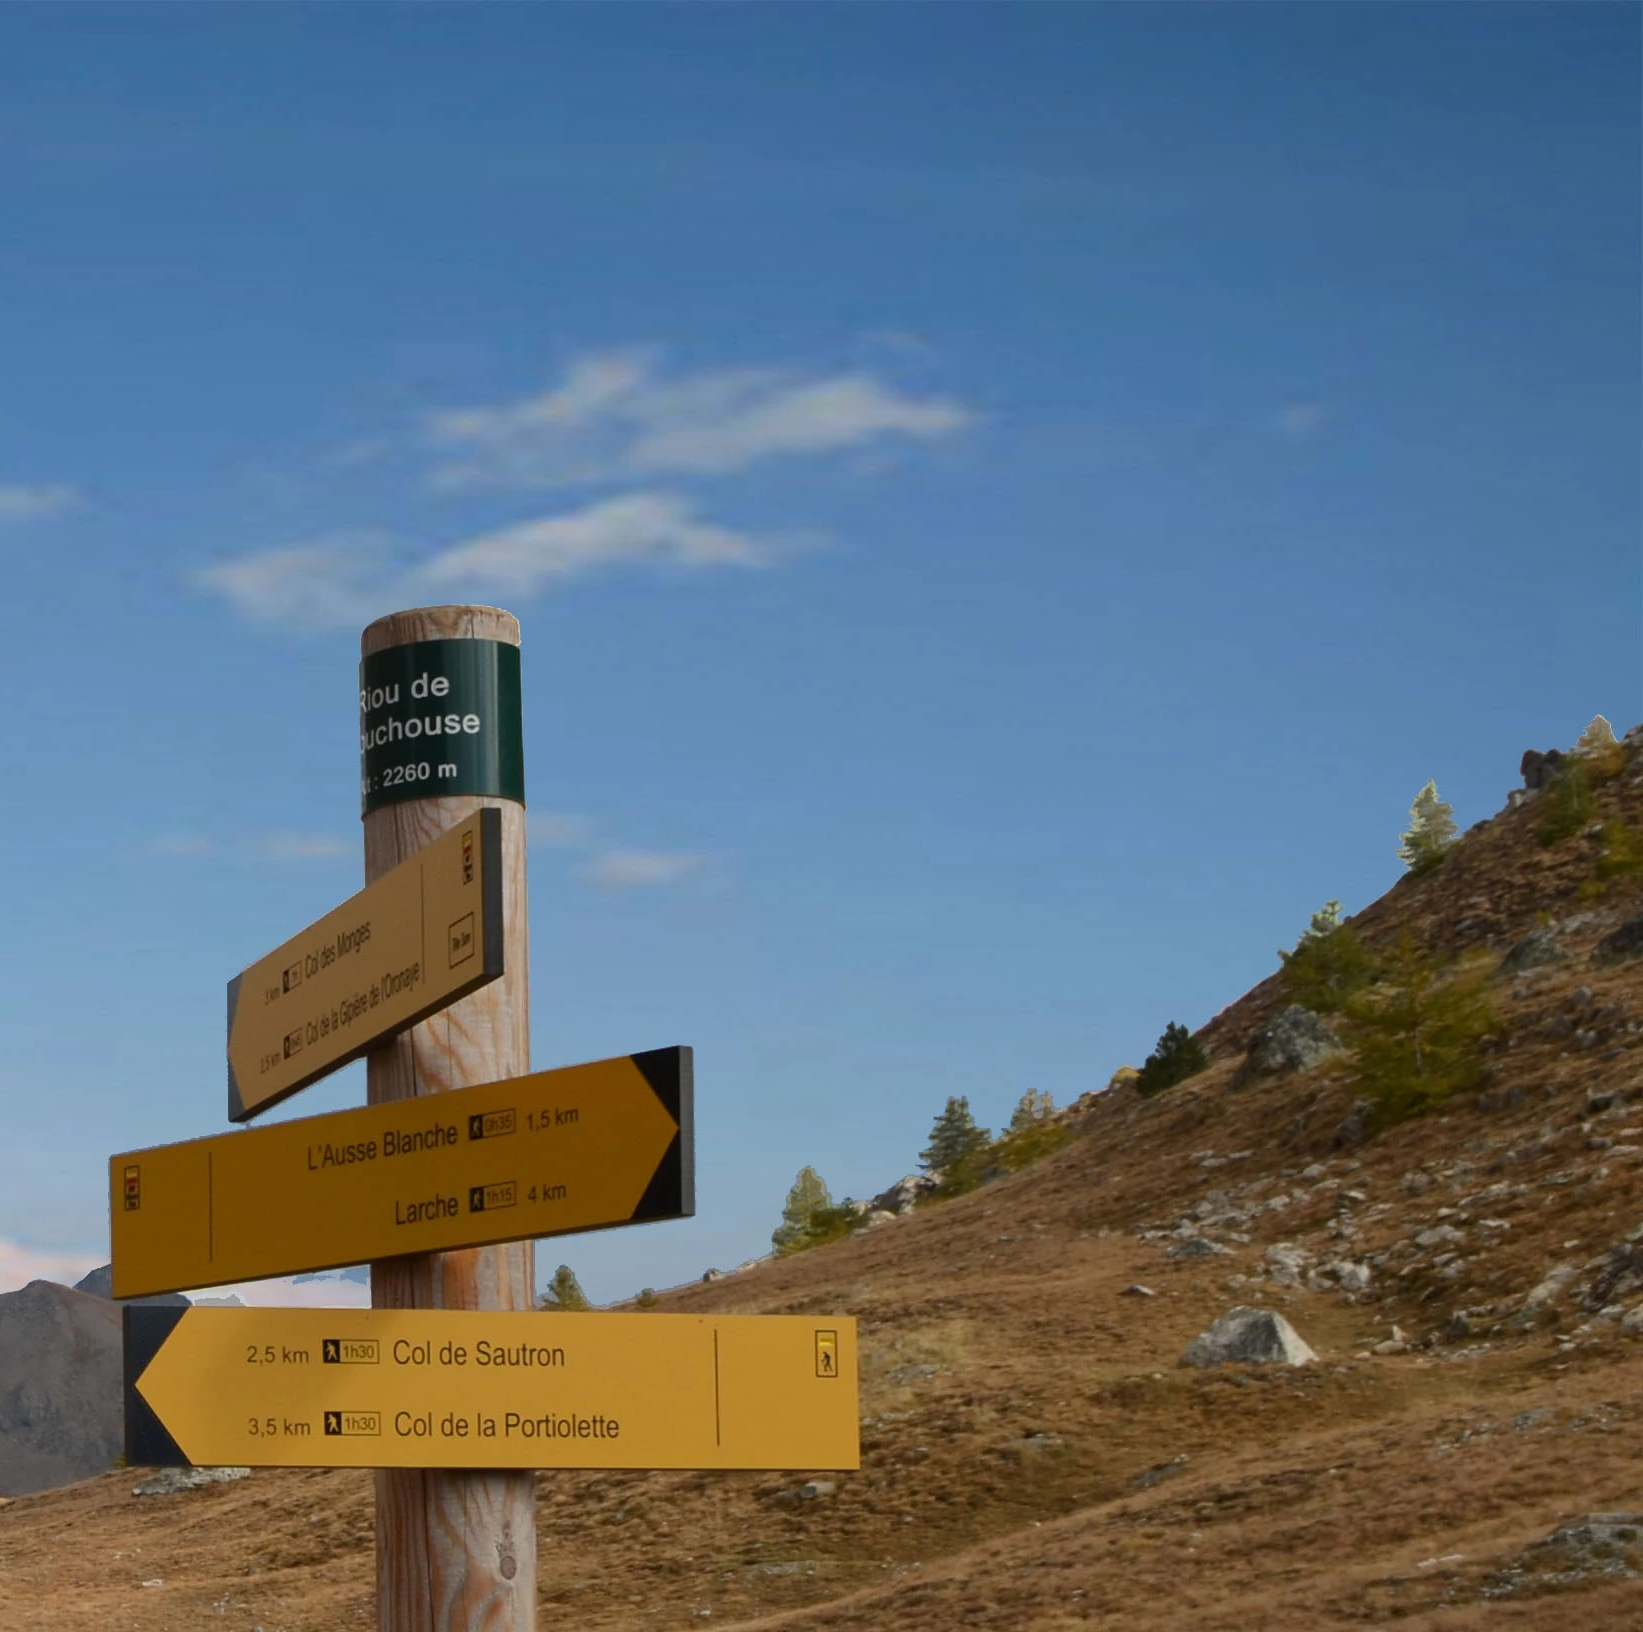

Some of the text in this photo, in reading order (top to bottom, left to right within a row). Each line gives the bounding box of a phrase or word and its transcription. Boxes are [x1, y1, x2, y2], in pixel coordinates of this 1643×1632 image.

[410, 672, 450, 699] de
[383, 762, 431, 787] 2260
[438, 763, 458, 778] m
[305, 954, 319, 979] Col
[320, 942, 336, 968] des
[337, 920, 372, 958] Monges
[306, 1019, 319, 1046] Col
[320, 1013, 331, 1038] de
[331, 1007, 339, 1031] la
[369, 983, 380, 1009] de
[307, 1141, 377, 1171] L'Ausse
[383, 1123, 458, 1157] Blanche
[526, 1109, 550, 1133] 1,5
[555, 1107, 579, 1126] km
[395, 1182, 567, 1226] Larche 1h15 4 km
[246, 1339, 565, 1367] 2,5 km 1h30 Col de Sautron
[247, 1411, 620, 1439] 3,5 km 1h30 Col de la Portiolette
